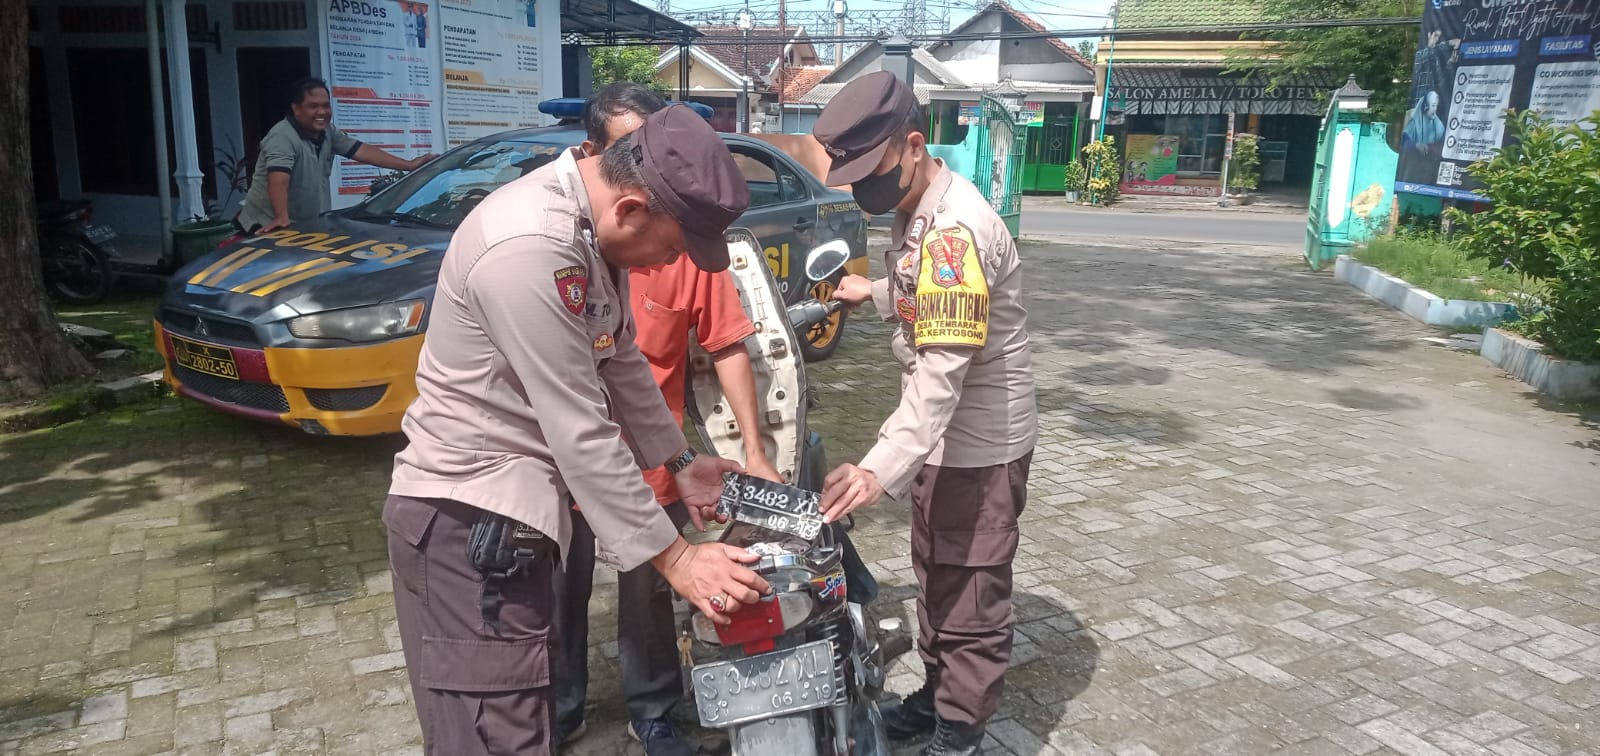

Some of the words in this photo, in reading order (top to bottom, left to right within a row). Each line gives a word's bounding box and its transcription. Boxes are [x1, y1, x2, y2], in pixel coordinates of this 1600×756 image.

[329, 0, 387, 18] APBDes
[1544, 40, 1584, 50] FASILITAS
[1108, 87, 1156, 100] SALON
[1157, 87, 1217, 99] AMELIA
[241, 230, 430, 265] POLISI
[927, 329, 984, 340] KERTOSONO
[935, 320, 978, 330] TEMBARAK
[191, 354, 235, 376] 2802-50
[728, 482, 741, 497] S
[744, 485, 789, 509] 3482
[793, 497, 818, 516] XL
[701, 671, 719, 700] S
[726, 657, 790, 696] 3482
[793, 648, 829, 682] XL
[771, 690, 794, 709] 06
[814, 682, 832, 701] 19
